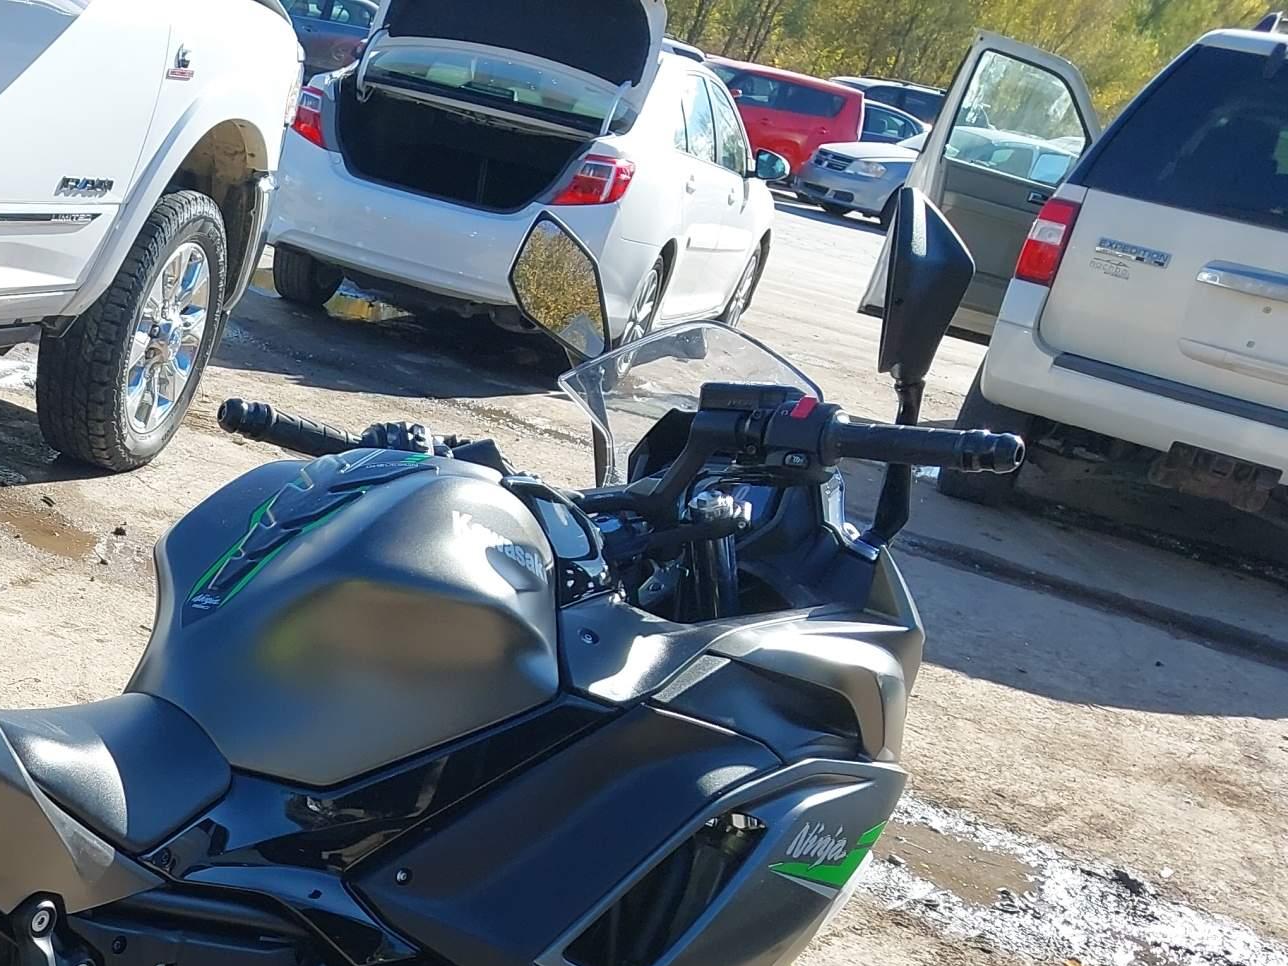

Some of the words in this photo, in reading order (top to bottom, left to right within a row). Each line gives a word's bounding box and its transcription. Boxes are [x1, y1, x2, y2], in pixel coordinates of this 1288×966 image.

[1098, 237, 1169, 263] EXPEDITION
[452, 510, 548, 585] Kawasaki
[785, 821, 847, 871] Ninja
